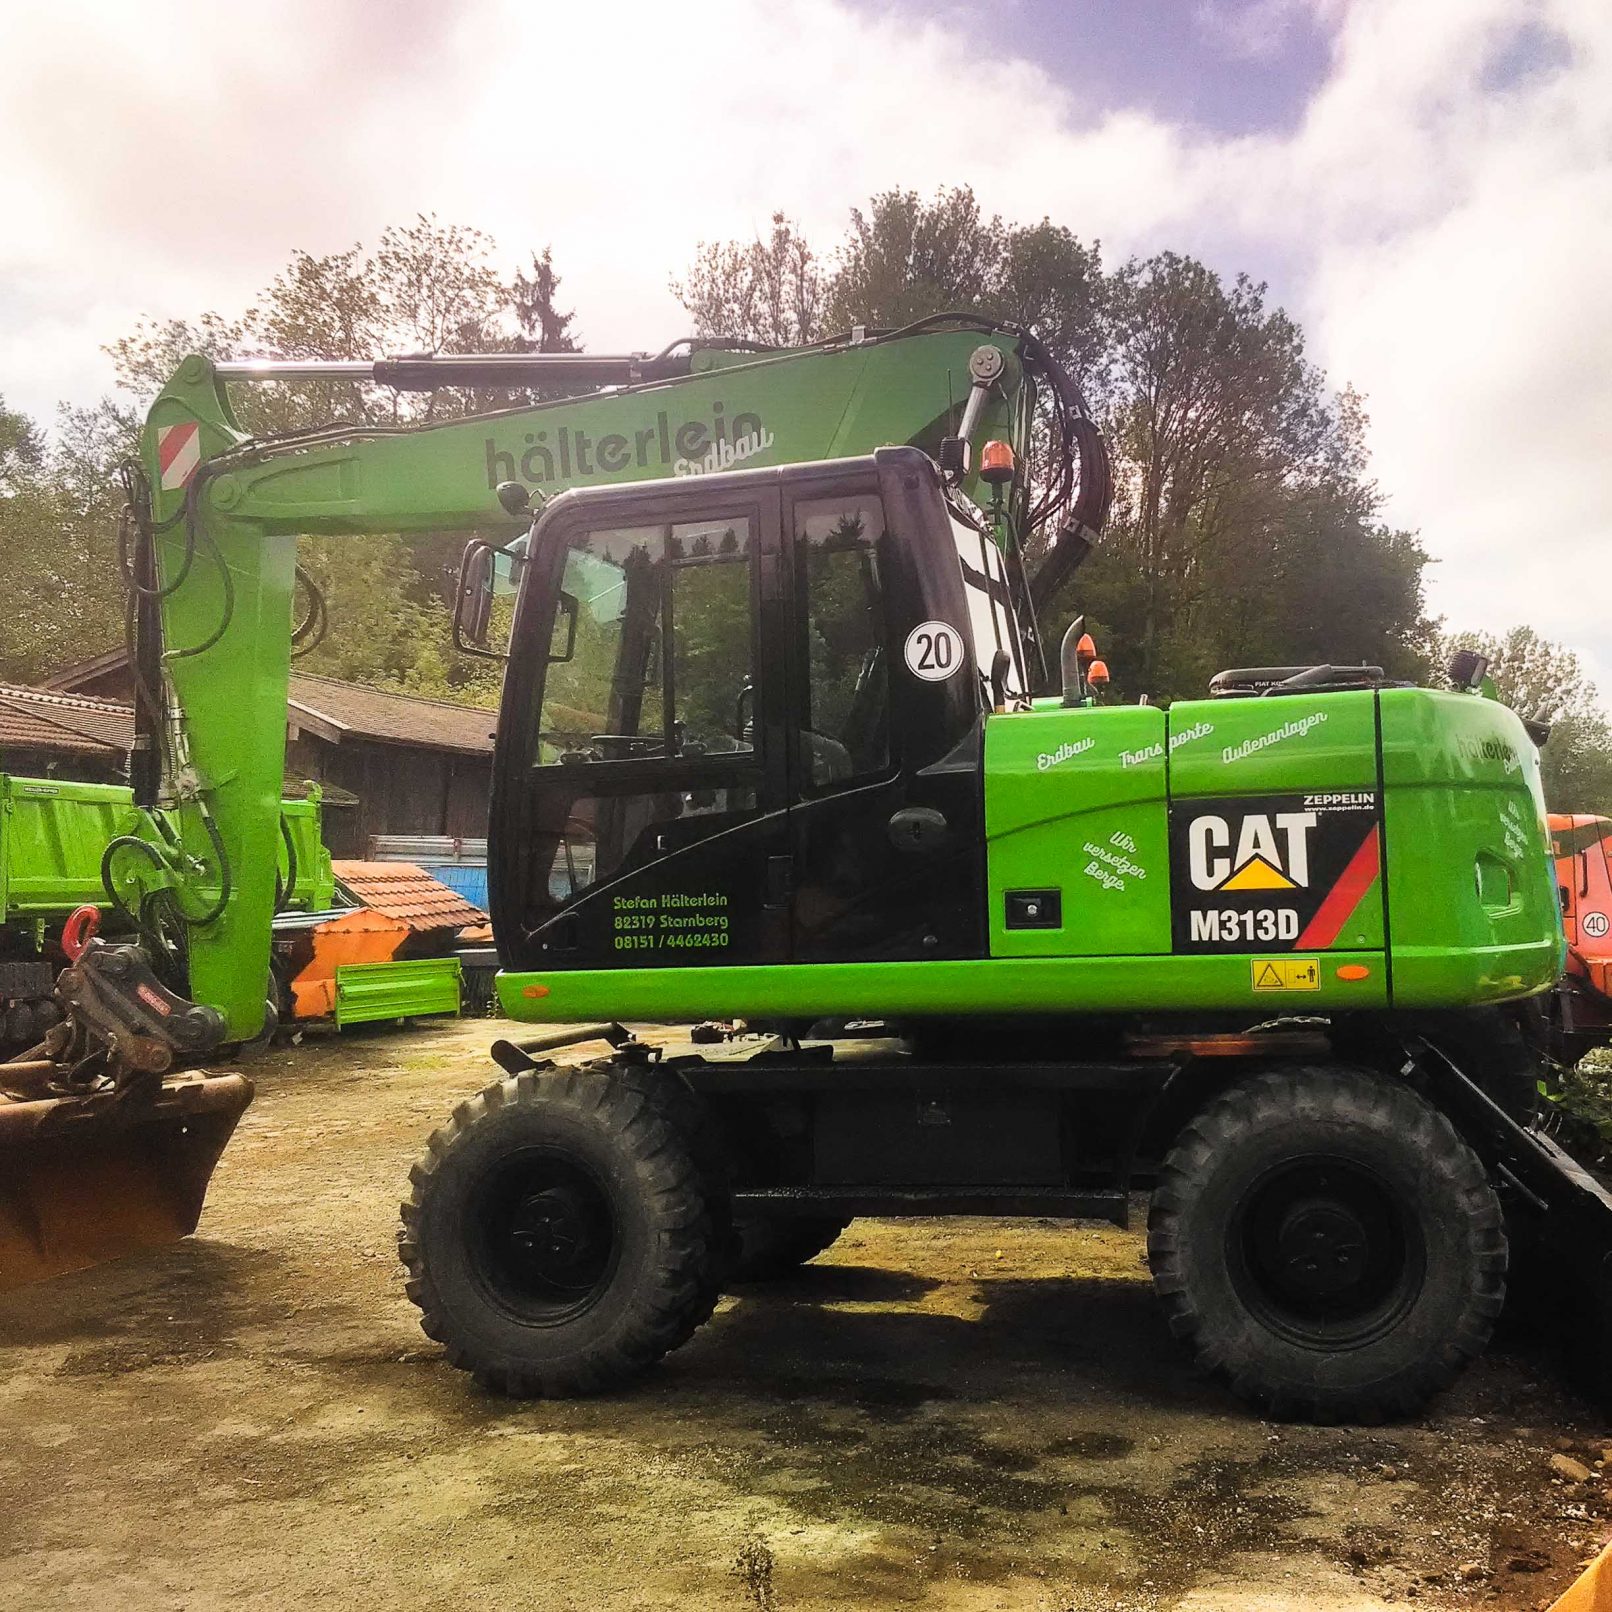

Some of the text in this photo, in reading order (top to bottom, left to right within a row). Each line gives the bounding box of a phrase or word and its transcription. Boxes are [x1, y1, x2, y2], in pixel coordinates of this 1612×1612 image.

[485, 400, 763, 490] hälterlein
[673, 427, 774, 477] Erdbau
[917, 632, 951, 670] 20
[1037, 737, 1095, 771] Erdbau
[1118, 722, 1214, 768] Transporte
[1222, 712, 1328, 764] Außenanlagen
[1303, 793, 1375, 805] ZEPPELIN
[1109, 831, 1137, 853] Wir
[1189, 811, 1317, 891] CAT
[1083, 842, 1146, 880] versetzen
[613, 893, 728, 910] Stefan Hälterlein
[614, 913, 729, 930] 82319 Starnberg
[1190, 909, 1299, 942] M313D
[1586, 916, 1606, 933] 40
[614, 935, 654, 950] 08151
[667, 932, 729, 948] 4462430
